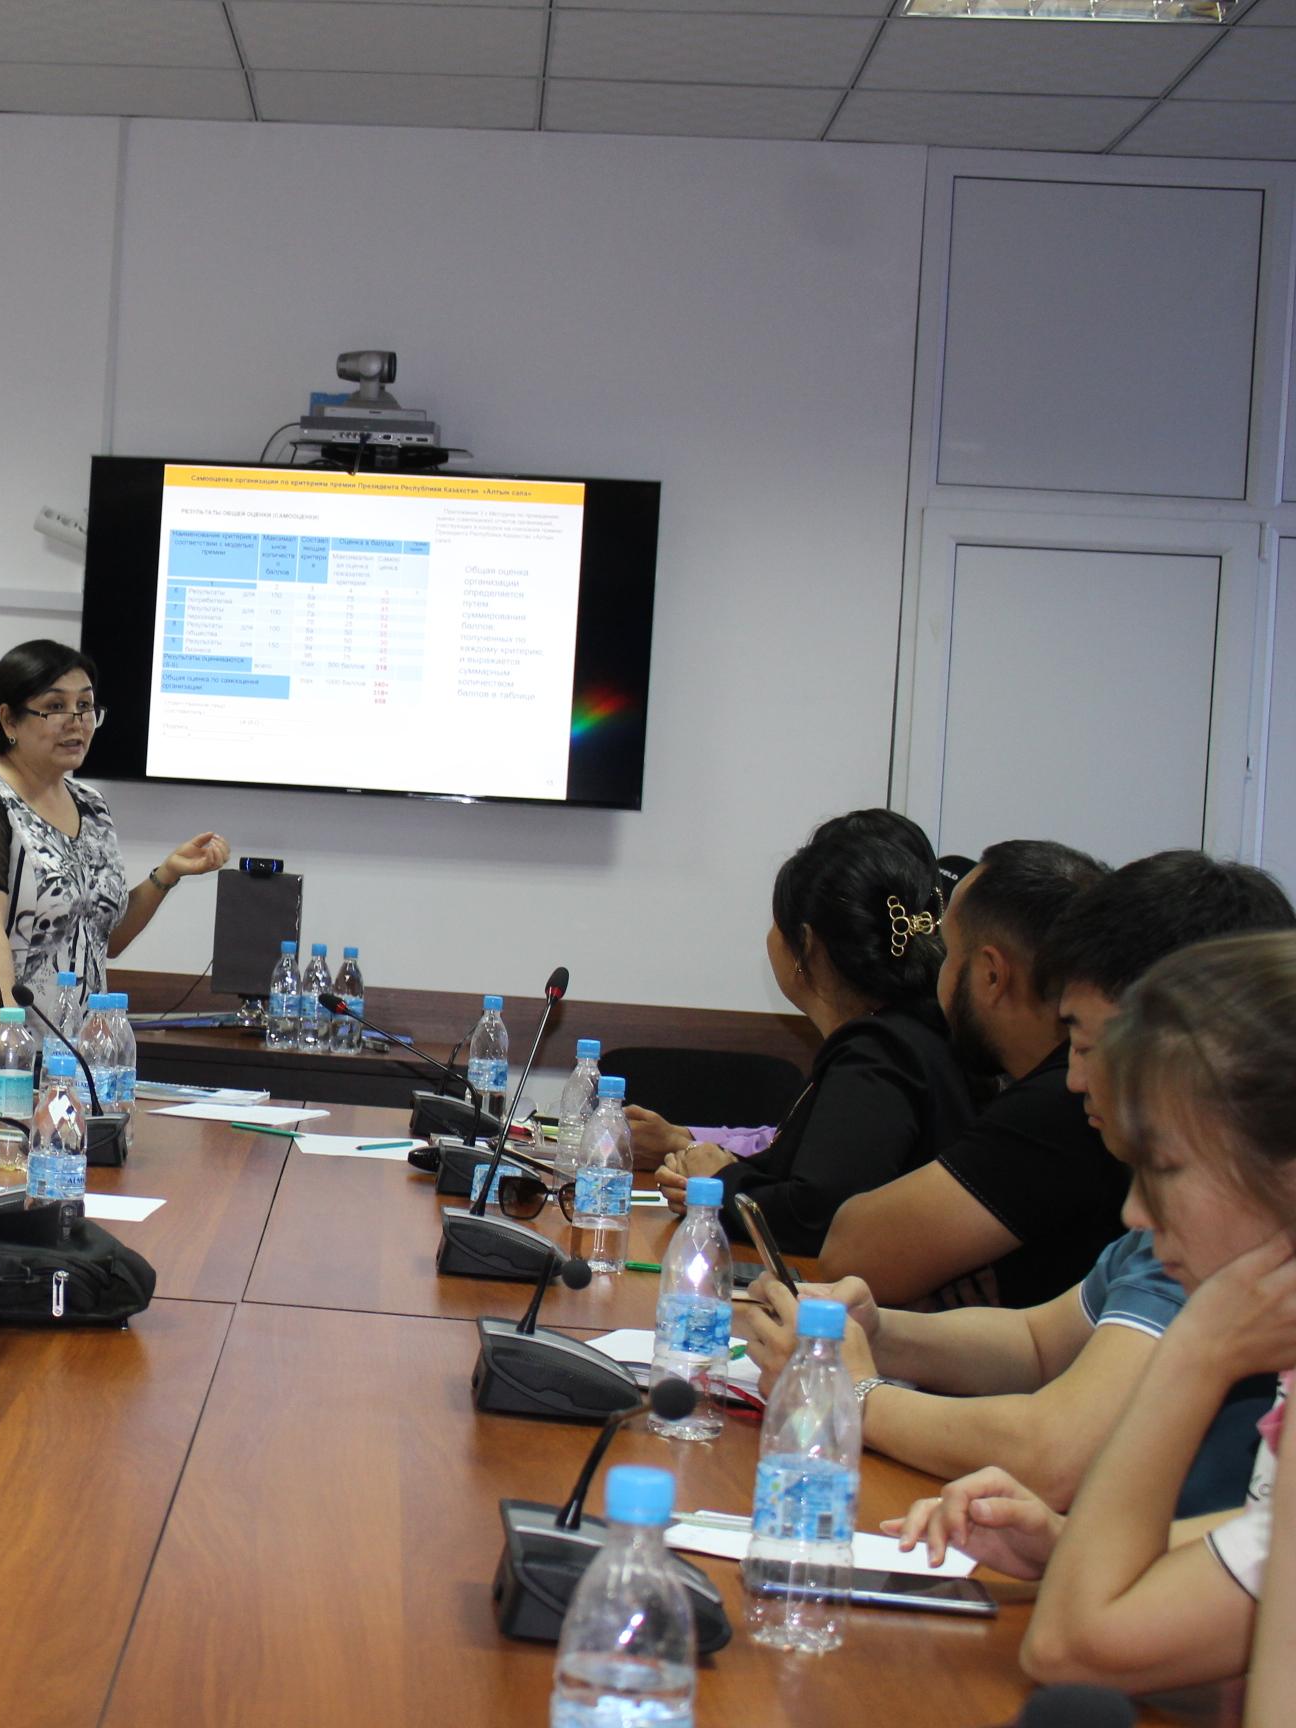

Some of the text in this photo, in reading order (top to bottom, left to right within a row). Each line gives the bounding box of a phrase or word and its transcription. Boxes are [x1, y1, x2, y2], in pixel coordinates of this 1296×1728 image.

[191, 475, 233, 483] Самооценка
[235, 478, 279, 486] организации
[290, 480, 328, 488] критериям
[358, 482, 399, 490] Президента
[401, 484, 442, 493] Республики
[339, 538, 364, 546] Оценка
[370, 539, 394, 547] баллах
[465, 566, 529, 577] Общая оценка
[464, 578, 520, 588] организации
[464, 589, 524, 599] определяется
[462, 600, 489, 609] путем
[462, 611, 526, 621] суммирования
[460, 645, 498, 656] каждому
[458, 667, 510, 677] суммарным
[457, 688, 489, 698] баллов
[500, 691, 536, 701] таблице
